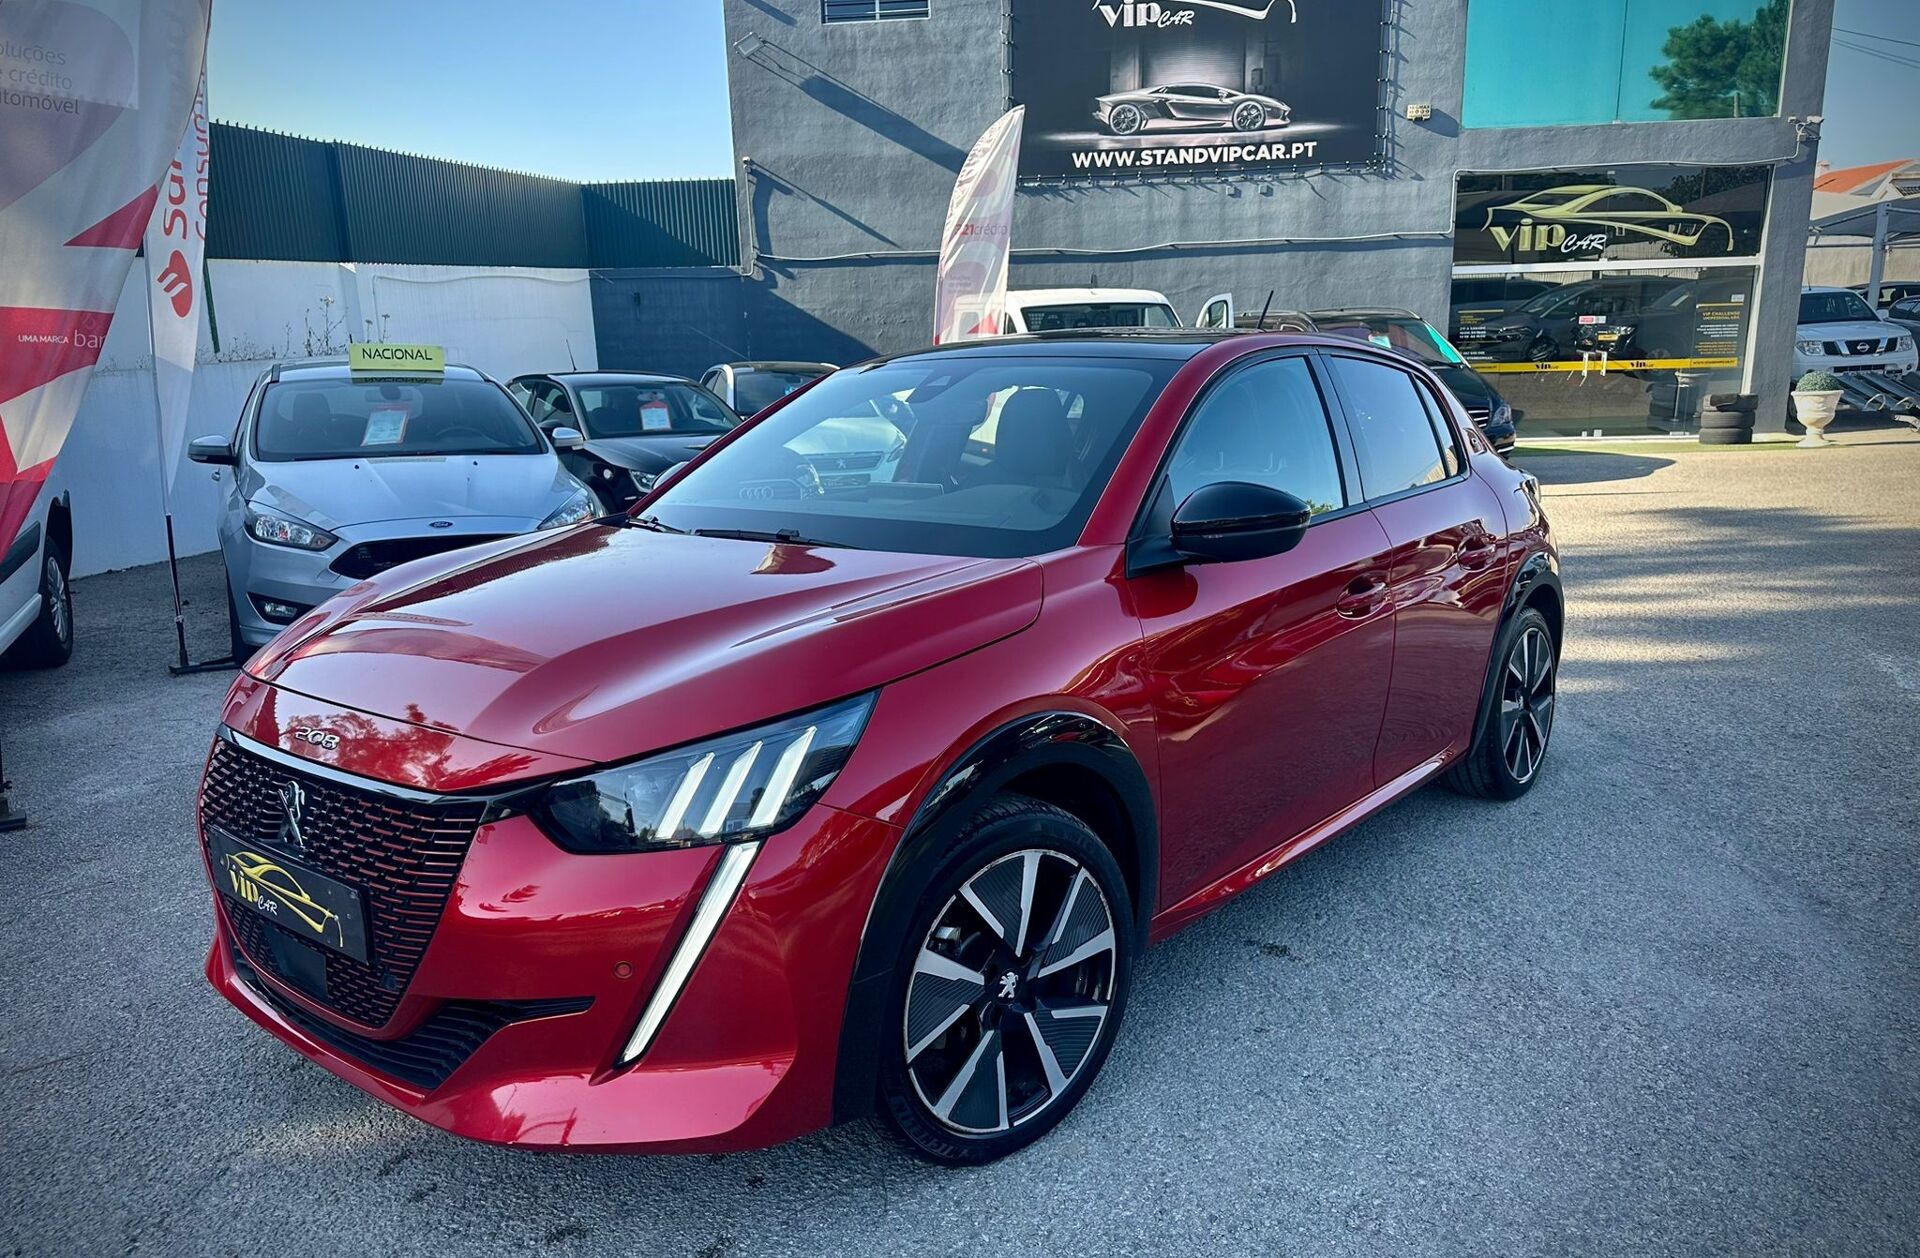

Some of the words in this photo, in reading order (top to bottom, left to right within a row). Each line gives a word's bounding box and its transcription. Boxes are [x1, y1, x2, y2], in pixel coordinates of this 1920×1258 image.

[1157, 10, 1195, 28] CAR
[8, 68, 73, 90] crédito
[1071, 141, 1317, 169] WWW.STANDVIPCAR.PT
[1560, 233, 1607, 253] CAR
[17, 334, 38, 343] UMA
[39, 334, 70, 344] MARCA
[362, 348, 433, 361] NACIONAL
[295, 726, 340, 750] 208
[257, 895, 278, 916] CAR
